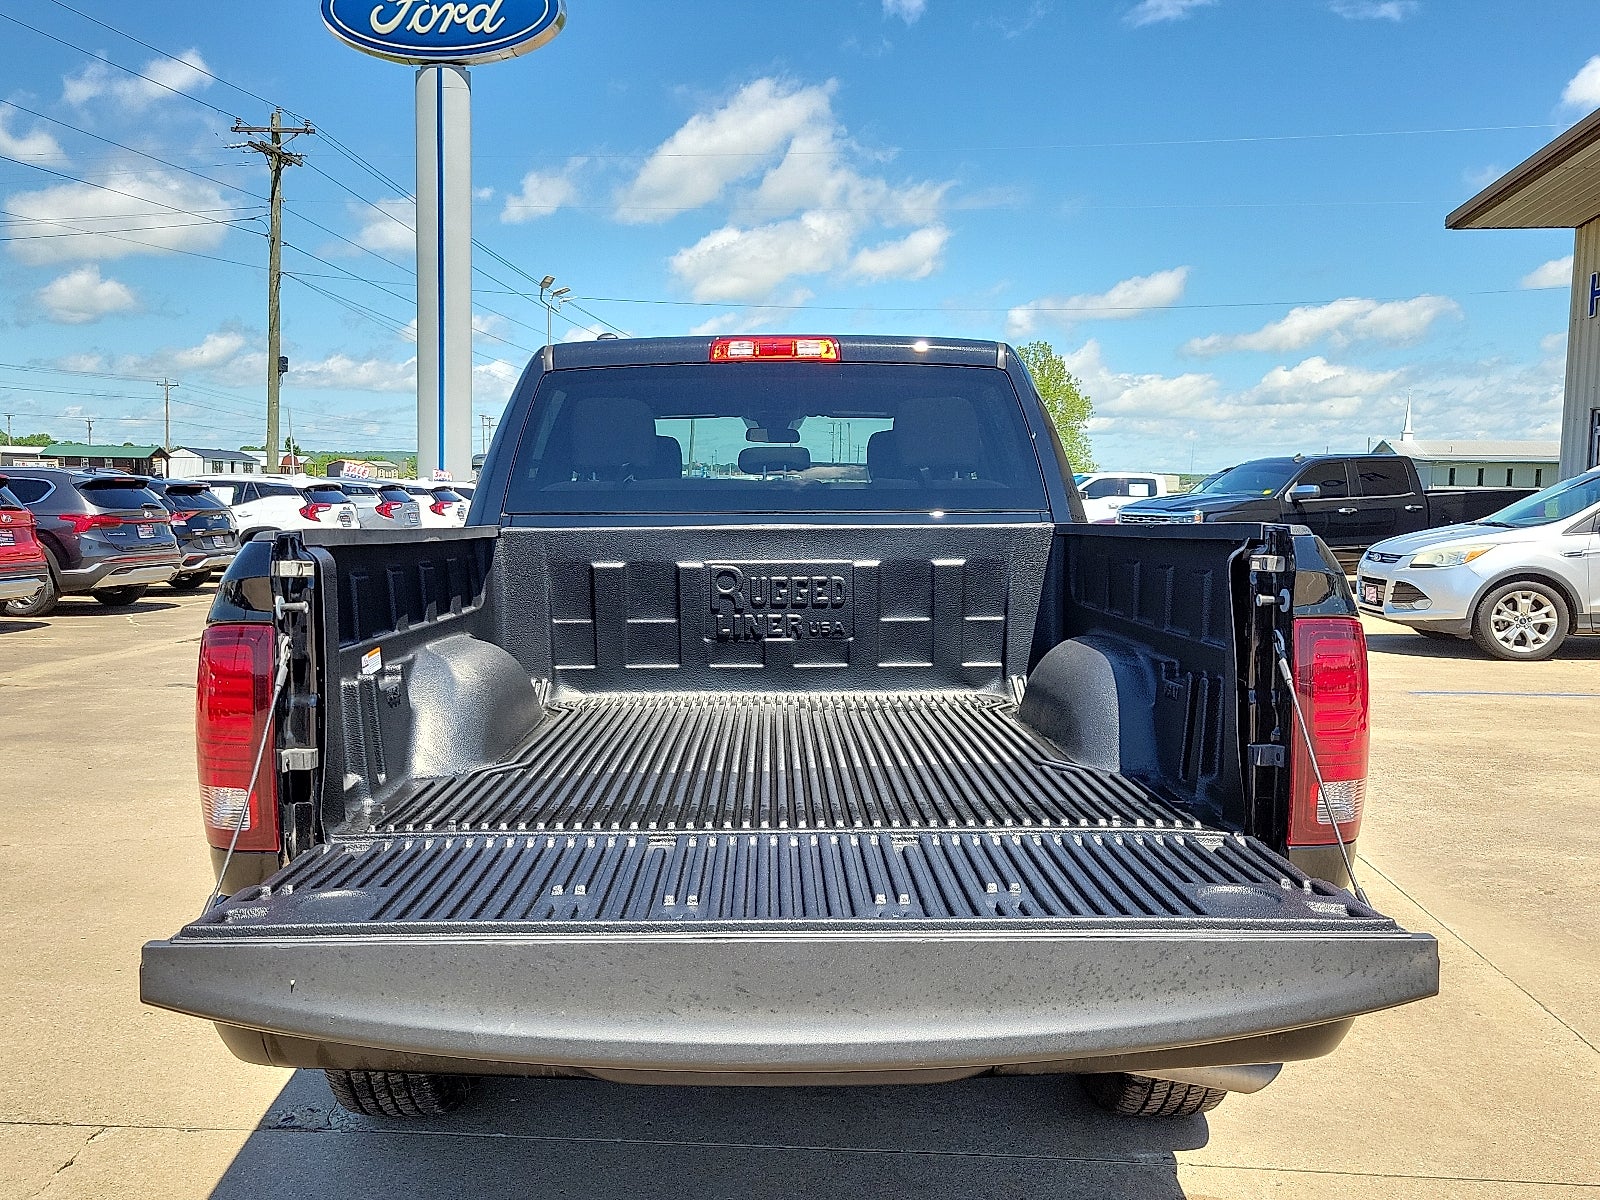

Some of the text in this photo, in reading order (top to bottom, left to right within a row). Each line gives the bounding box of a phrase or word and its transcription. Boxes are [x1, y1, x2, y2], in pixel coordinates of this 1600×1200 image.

[369, 0, 506, 35] Ford
[346, 464, 367, 477] SALE
[709, 564, 847, 614] RUGGED
[715, 614, 846, 642] LINER USA
